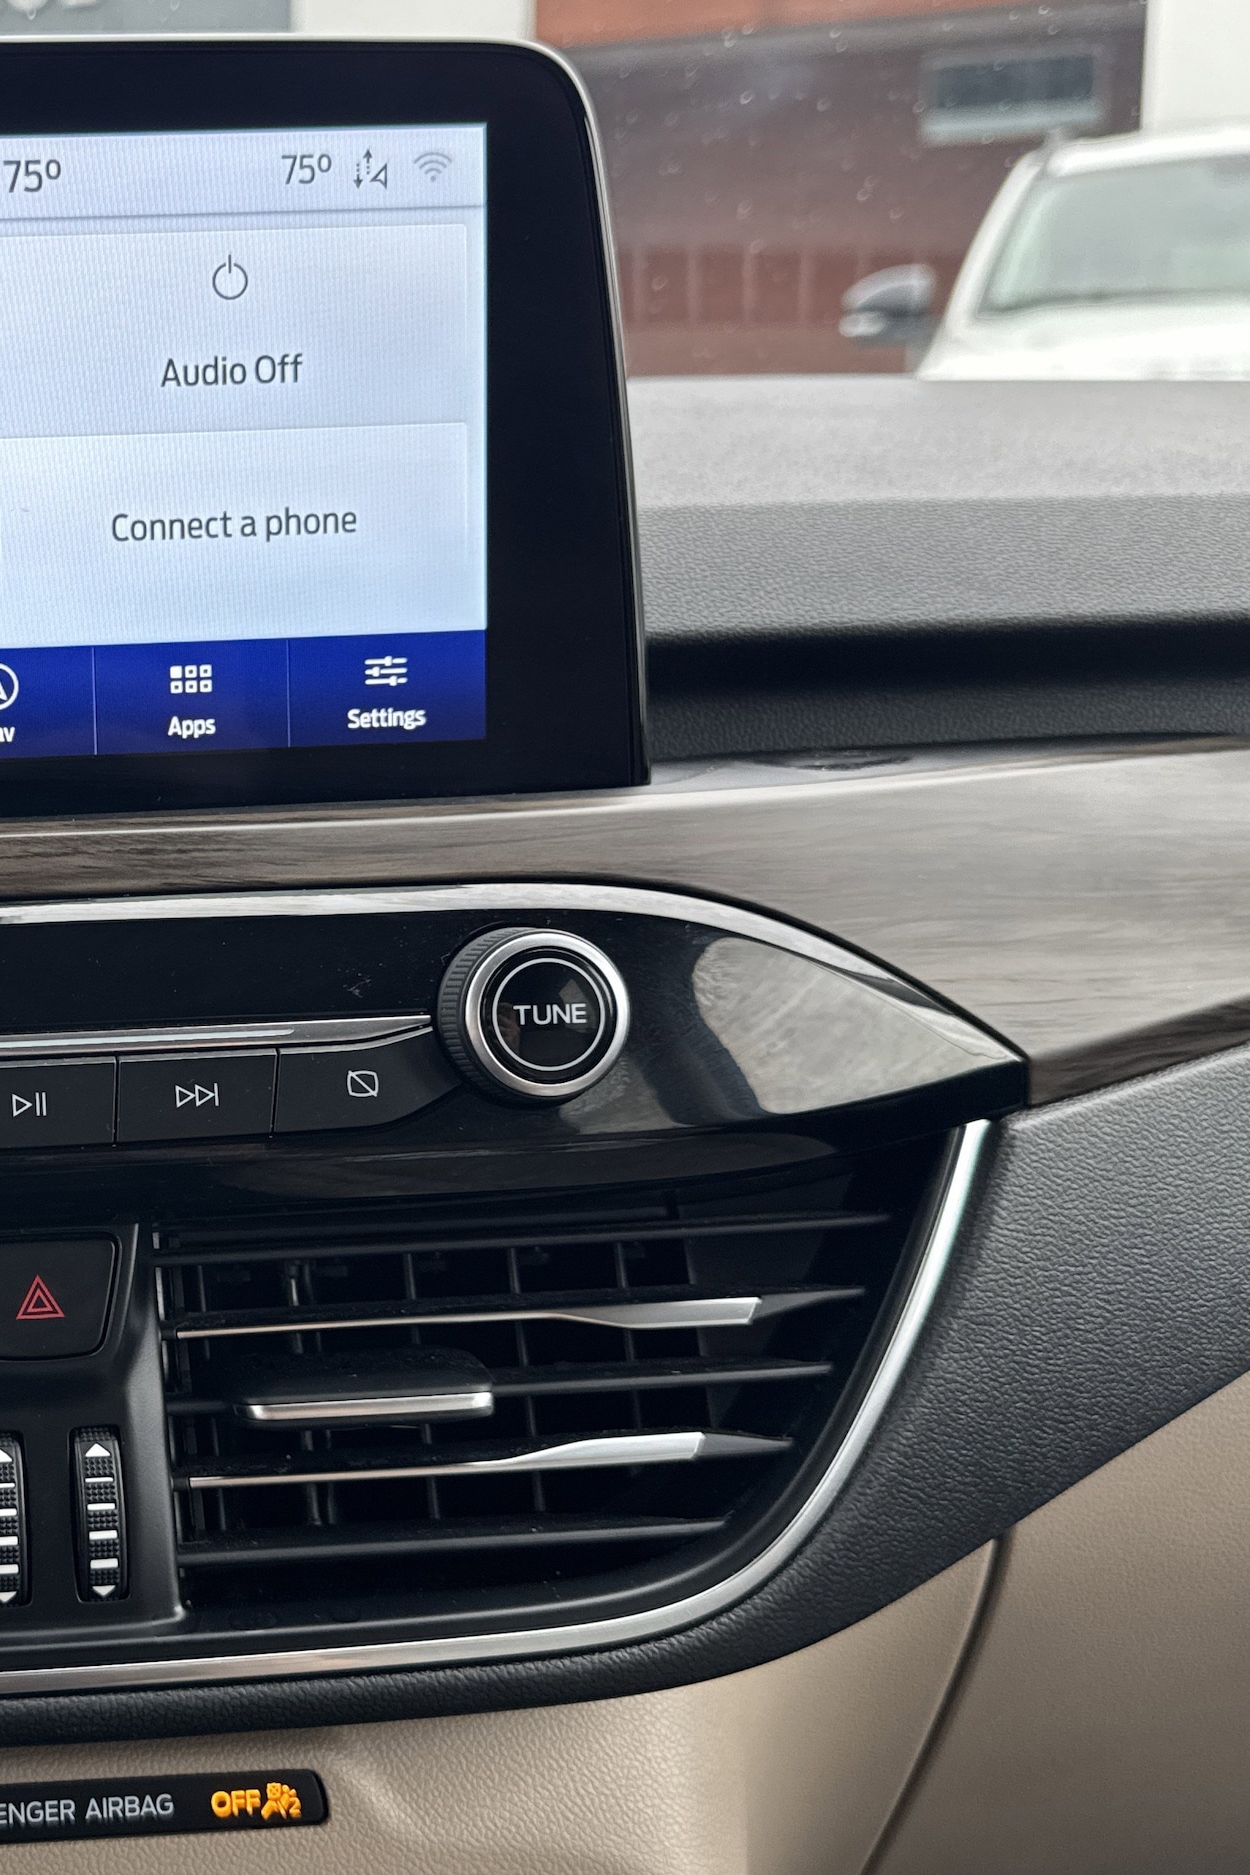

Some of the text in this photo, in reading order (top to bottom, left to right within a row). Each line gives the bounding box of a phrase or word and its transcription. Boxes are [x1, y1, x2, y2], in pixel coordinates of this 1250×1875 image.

[160, 352, 303, 388] Audio Off
[111, 506, 357, 543] Connect a phone
[167, 715, 217, 739] Apps
[347, 707, 427, 731] Settings
[512, 1002, 588, 1026] TUNE
[85, 1793, 174, 1820] AIRBAG
[210, 1790, 262, 1818] OFF
